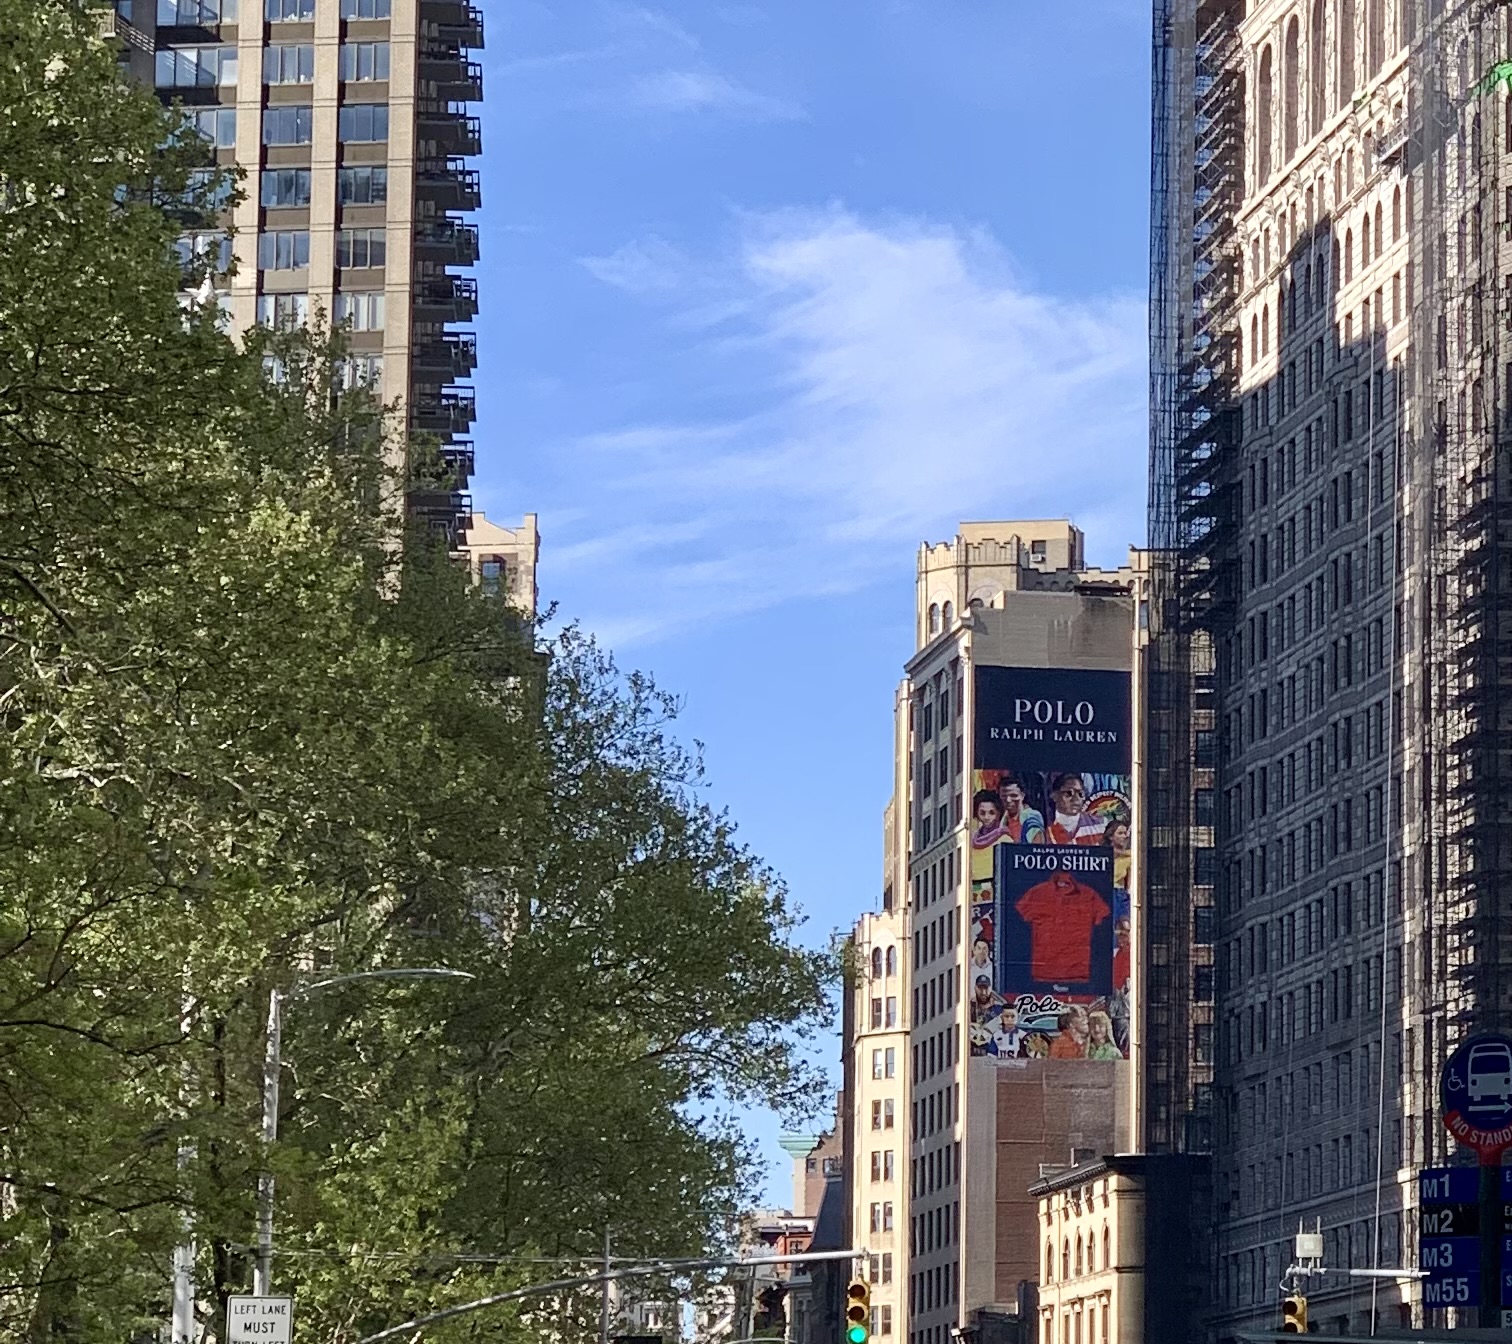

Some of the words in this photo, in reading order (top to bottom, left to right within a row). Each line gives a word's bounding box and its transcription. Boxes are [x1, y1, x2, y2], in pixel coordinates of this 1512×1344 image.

[1014, 699, 1094, 725] POLO
[990, 727, 1044, 741] RALPH
[1053, 730, 1117, 743] LAUREN
[1014, 854, 1058, 870] POLO
[1062, 855, 1109, 872] SHIRT
[1017, 995, 1061, 1013] Polo
[1450, 1115, 1466, 1137] NO
[1422, 1173, 1450, 1198] M1
[1422, 1210, 1454, 1234] M2
[1422, 1243, 1454, 1268] M3
[1425, 1277, 1470, 1303] M55
[234, 1304, 257, 1315] LEFT
[262, 1305, 287, 1315] LANE
[1505, 1313, 1512, 1323] 5
[243, 1322, 276, 1334] MUST
